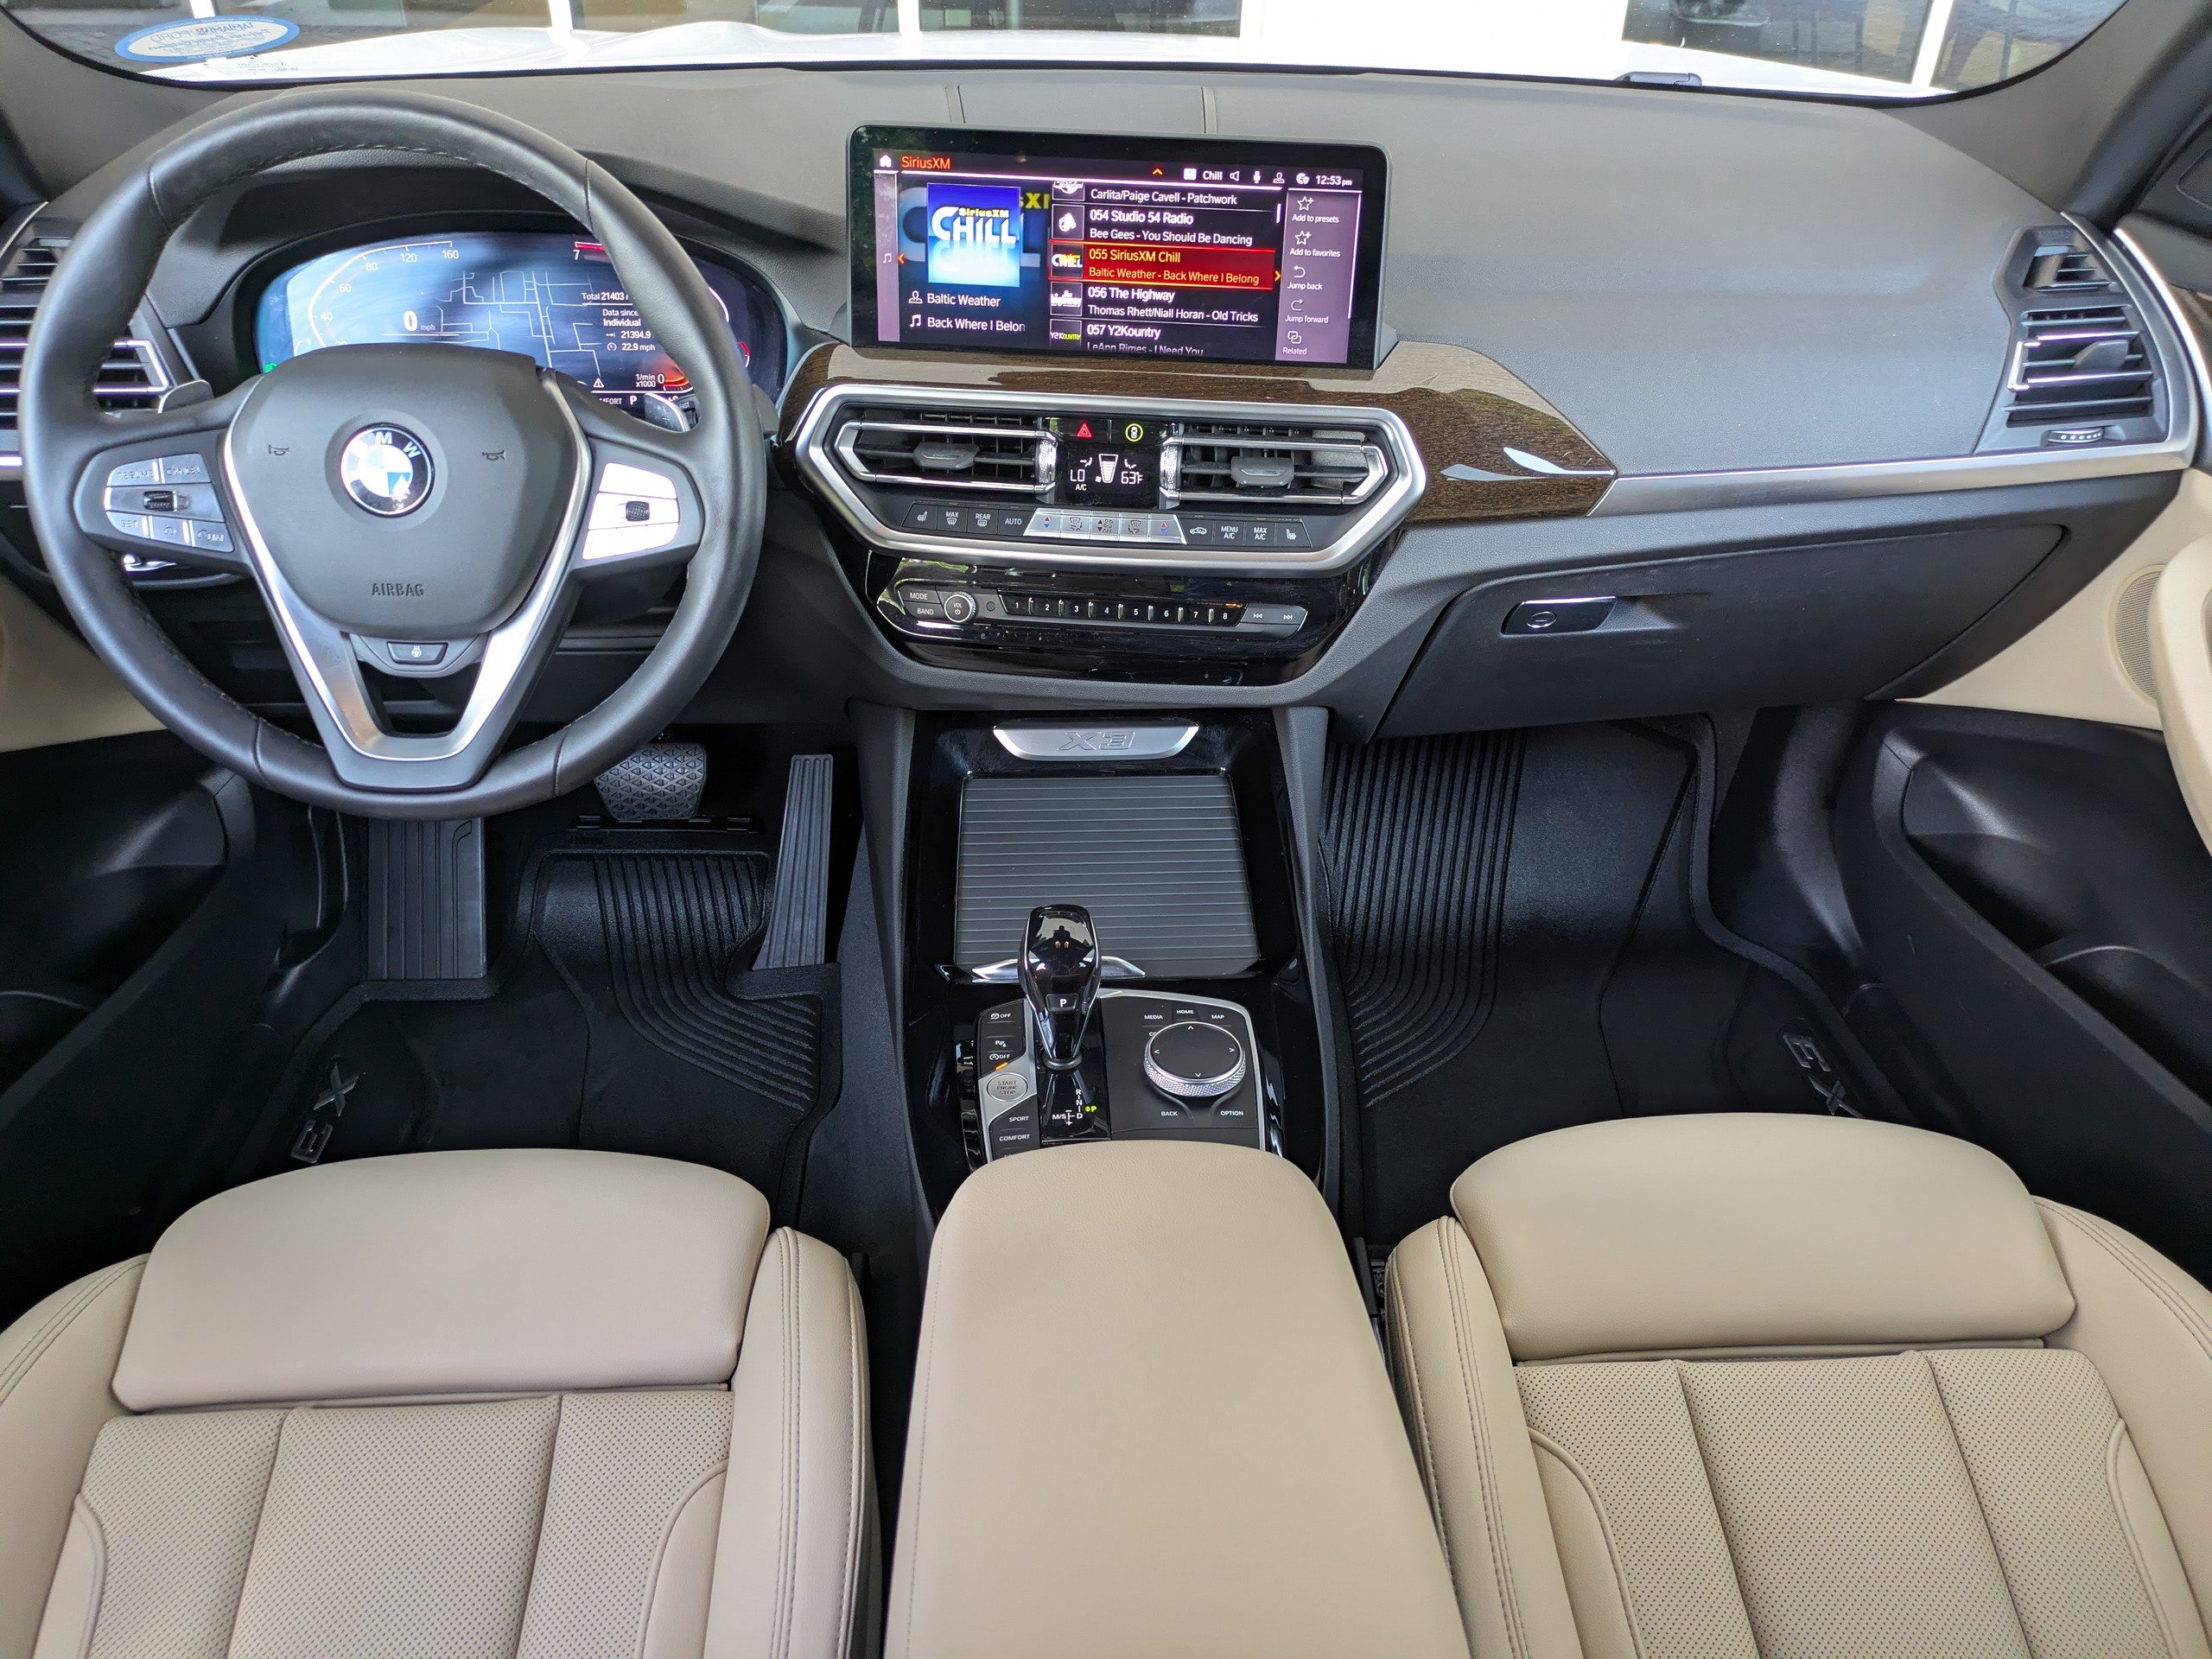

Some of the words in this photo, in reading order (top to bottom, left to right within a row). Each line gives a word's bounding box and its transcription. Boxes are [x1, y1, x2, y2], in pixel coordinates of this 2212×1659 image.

[901, 156, 951, 169] SiriusXM
[1202, 170, 1224, 181] Chill
[1315, 175, 1342, 186] 12:53
[1342, 179, 1353, 188] pm
[1090, 189, 1150, 203] Carlita/Paige
[1152, 192, 1180, 203] Cavell
[1187, 193, 1237, 205] Patchwork
[958, 208, 1009, 218] SiriusXM
[1090, 208, 1109, 221] 054
[1110, 210, 1146, 223] Studio
[1147, 211, 1161, 224] 54
[1162, 212, 1194, 225] Radio
[1292, 213, 1306, 222] Add
[1314, 215, 1340, 224] presets
[931, 206, 1017, 244] CHILL
[1090, 228, 1109, 238] Bee
[1110, 229, 1135, 240] Gees
[1141, 230, 1161, 241] You
[1162, 232, 1196, 243] Should
[1198, 232, 1211, 244] Be
[1212, 234, 1253, 247] Dancing
[400, 253, 417, 263] 120
[442, 250, 460, 259] 160
[573, 250, 581, 260] 7
[1089, 248, 1108, 261] 055
[1109, 250, 1156, 262] SiriusXM
[1158, 251, 1181, 264] Chill
[1312, 249, 1341, 257] favorites
[365, 262, 378, 271] 80
[1089, 266, 1116, 276] Baltic
[1116, 268, 1157, 279] Weather
[1163, 270, 1187, 281] Back
[1188, 270, 1219, 282] Where
[1225, 272, 1260, 286] Belong
[339, 283, 352, 293] 60
[1287, 282, 1306, 290] Jump
[582, 292, 601, 301] Total
[601, 292, 625, 301] 21403
[927, 292, 957, 305] Baltic
[957, 294, 1001, 308] Weather
[1088, 286, 1108, 299] 056
[1108, 287, 1129, 299] The
[1131, 288, 1176, 304] Highway
[321, 312, 334, 321] 40
[1087, 304, 1126, 316] Thomas
[1127, 306, 1174, 318] Rhett/Niall
[1175, 308, 1205, 320] Horan
[1211, 309, 1229, 321] Old
[1230, 310, 1259, 322] Tricks
[403, 310, 418, 332] 0
[603, 318, 641, 327] Individual
[927, 316, 954, 329] Back
[955, 318, 988, 330] Where
[1284, 315, 1305, 324] Jump
[1304, 315, 1329, 324] forward
[620, 330, 652, 340] 21394.9
[1086, 324, 1107, 336] 057
[1107, 325, 1161, 340] Y2Kountry
[1087, 342, 1116, 352] LeAnn
[1118, 343, 1147, 353] Rimes
[1159, 345, 1184, 355] Need
[1185, 346, 1204, 356] You
[1282, 346, 1307, 355] Related
[635, 373, 656, 382] 1/min
[658, 374, 665, 385] 0
[629, 395, 638, 405] P
[1070, 469, 1086, 482] LO
[372, 582, 424, 597] AIRBAG
[1223, 612, 1228, 620] 8
[1056, 731, 1136, 751] X3
[1059, 998, 1067, 1007] P
[999, 1134, 1031, 1142] COMFORT
